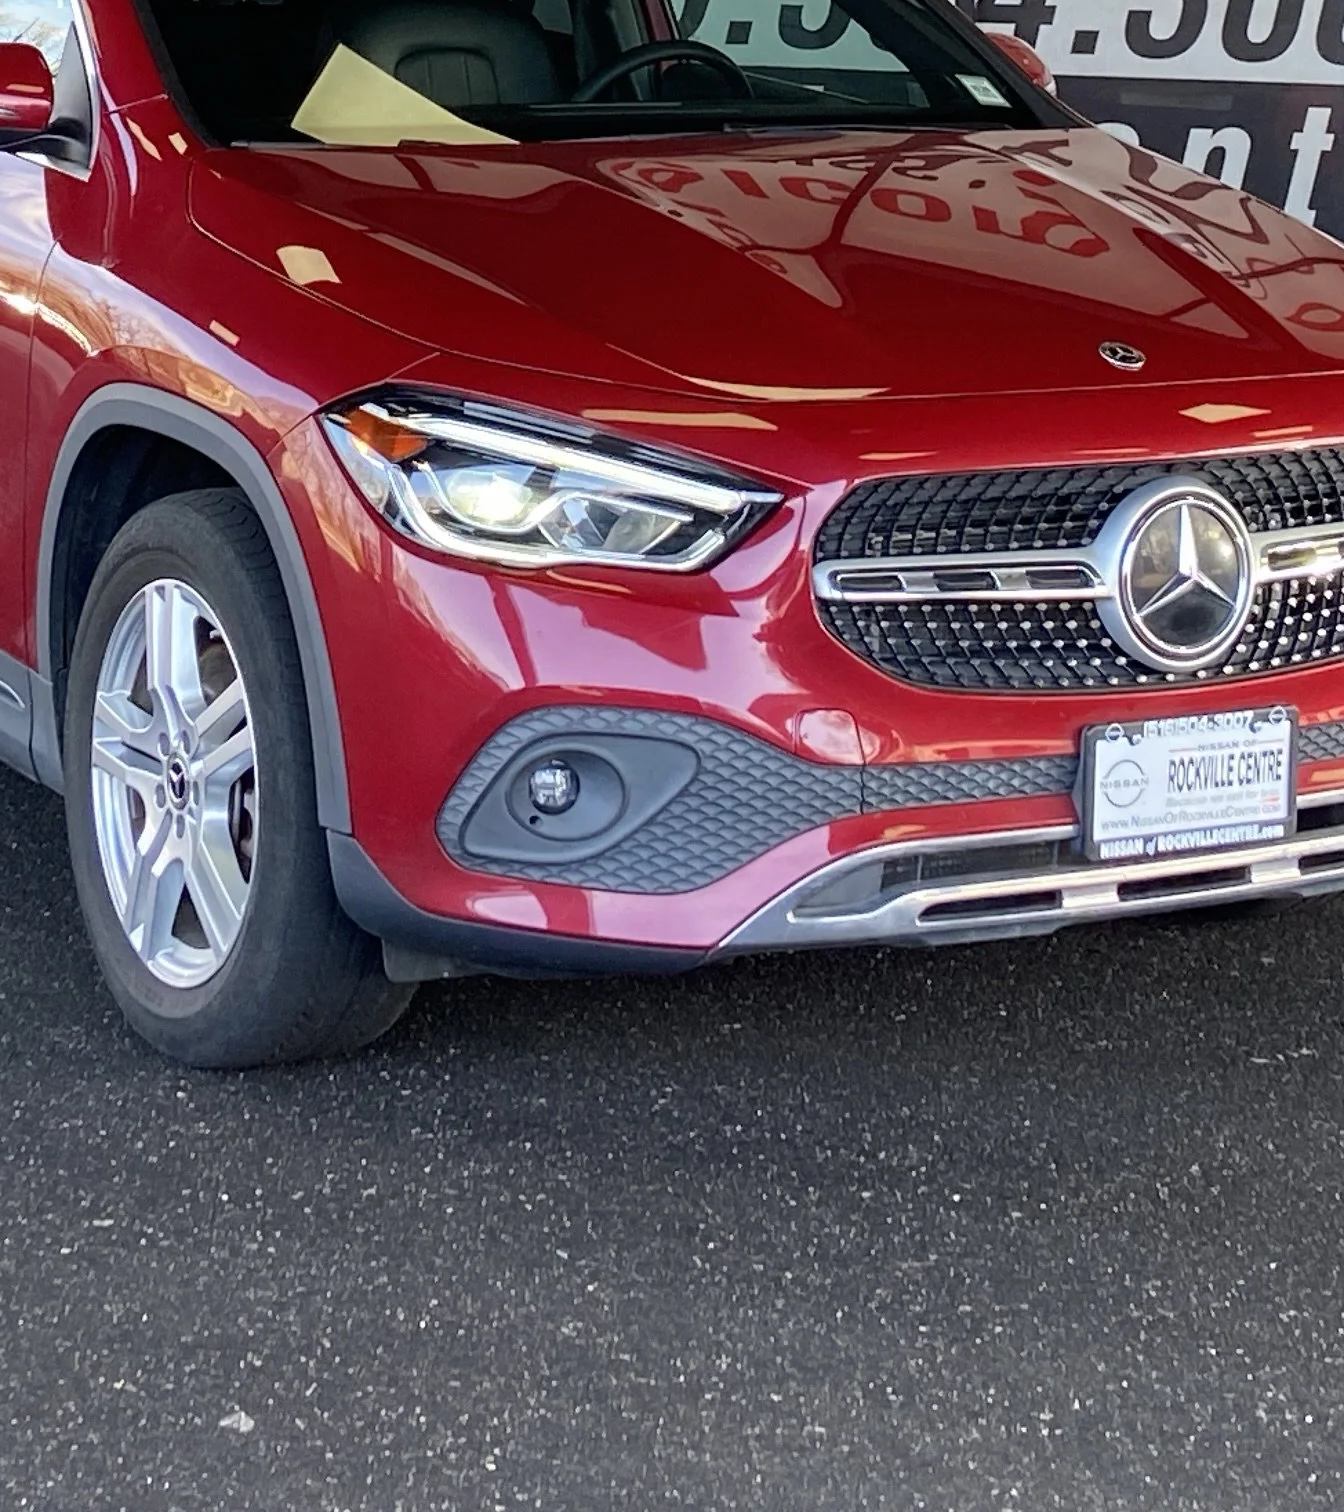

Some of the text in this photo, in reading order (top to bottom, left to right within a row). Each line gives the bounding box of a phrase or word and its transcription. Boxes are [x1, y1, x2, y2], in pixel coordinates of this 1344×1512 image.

[1197, 740, 1239, 752] NISSAN
[1167, 748, 1283, 793] ROCKVILLE CENTRE
[1100, 777, 1149, 789] NISSAN
[1100, 837, 1144, 860] NISSAN
[1145, 836, 1157, 856] of
